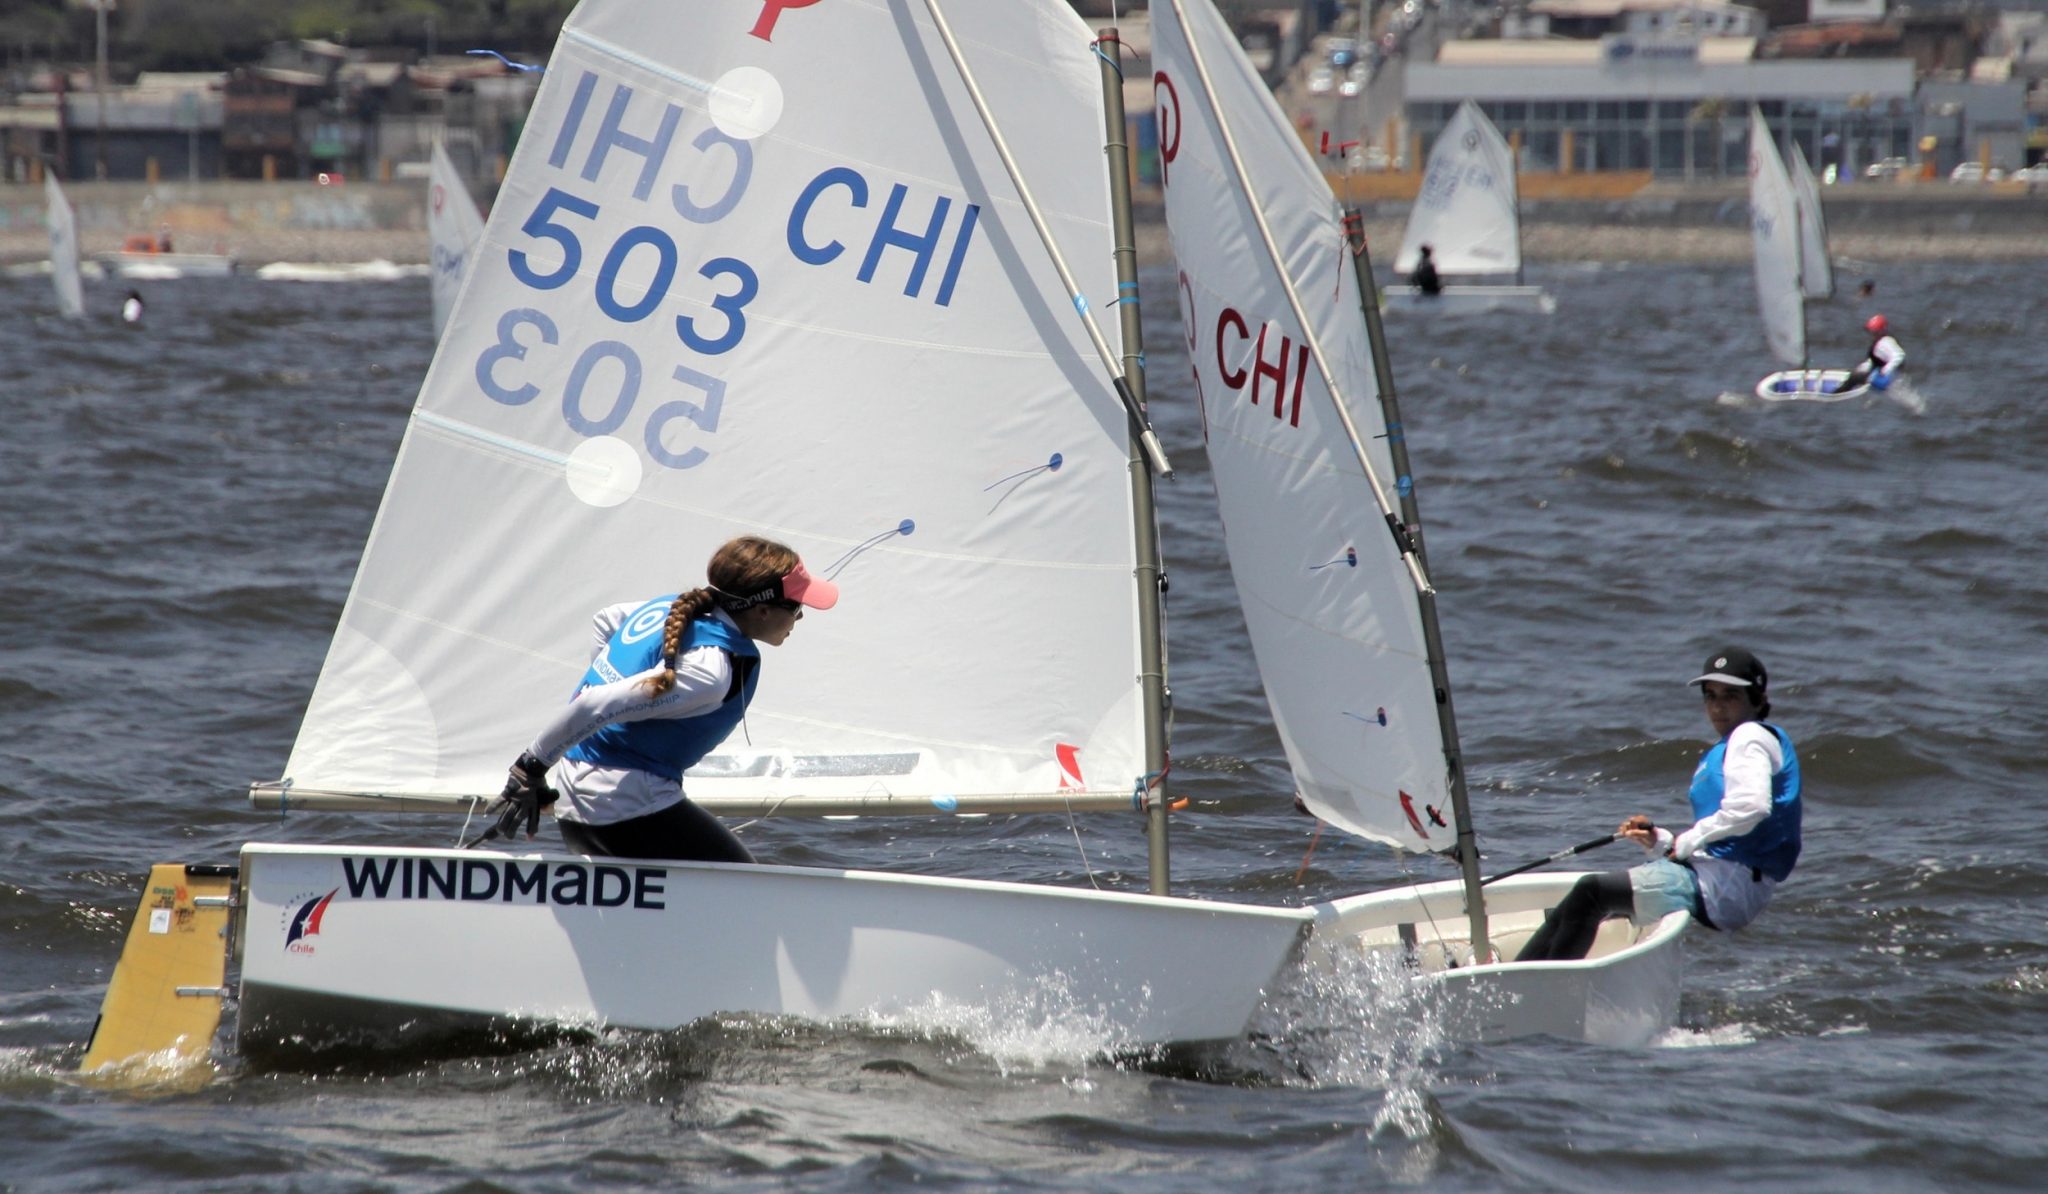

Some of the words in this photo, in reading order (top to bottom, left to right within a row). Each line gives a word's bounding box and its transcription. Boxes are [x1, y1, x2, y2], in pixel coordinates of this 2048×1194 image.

[508, 186, 759, 355] 503
[786, 166, 980, 307] CHI
[1216, 307, 1310, 428] CHI
[290, 944, 315, 954] Chile
